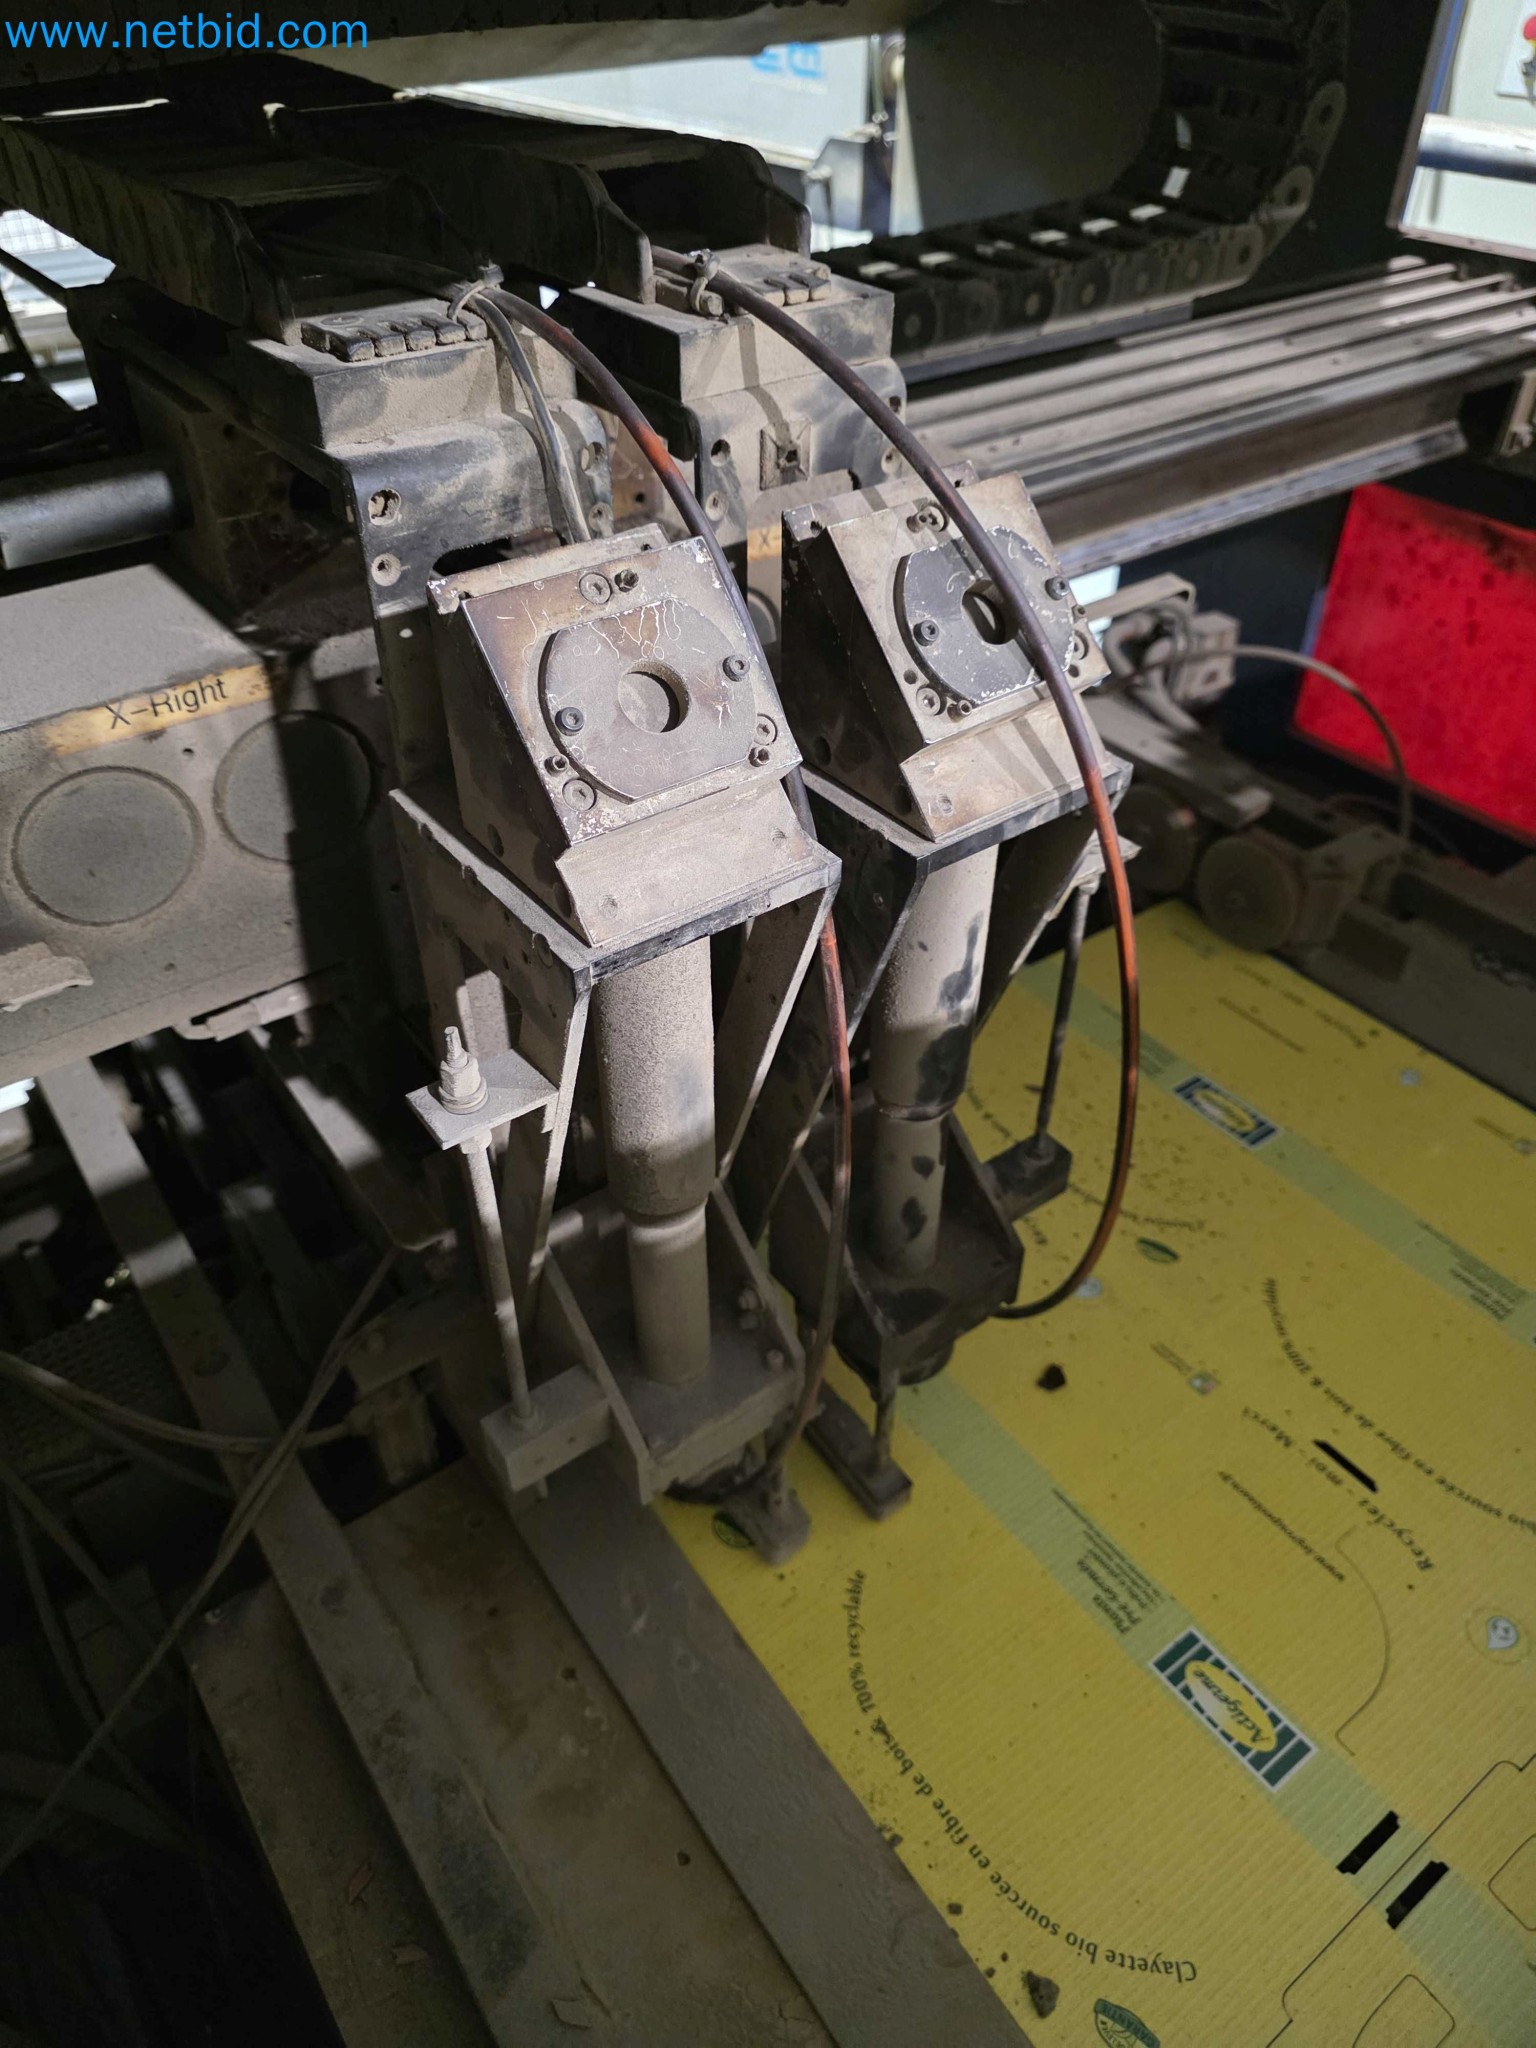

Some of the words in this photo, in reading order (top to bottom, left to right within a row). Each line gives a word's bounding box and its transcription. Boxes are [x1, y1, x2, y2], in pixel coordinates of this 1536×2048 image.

[105, 678, 230, 729] X-Right
[1241, 1406, 1292, 1447] Merci
[1306, 1456, 1343, 1488] moi
[842, 1569, 866, 1658] recyclable
[849, 1661, 876, 1715] 100%
[1192, 1668, 1271, 1744] Actigerme
[883, 1734, 914, 1775] bois
[913, 1772, 933, 1796] de
[933, 1798, 969, 1845] fibre
[968, 1843, 991, 1869] en
[989, 1871, 1061, 1936] sourcée
[1065, 1932, 1098, 1964] bio
[1105, 1949, 1198, 1983] Clayette
